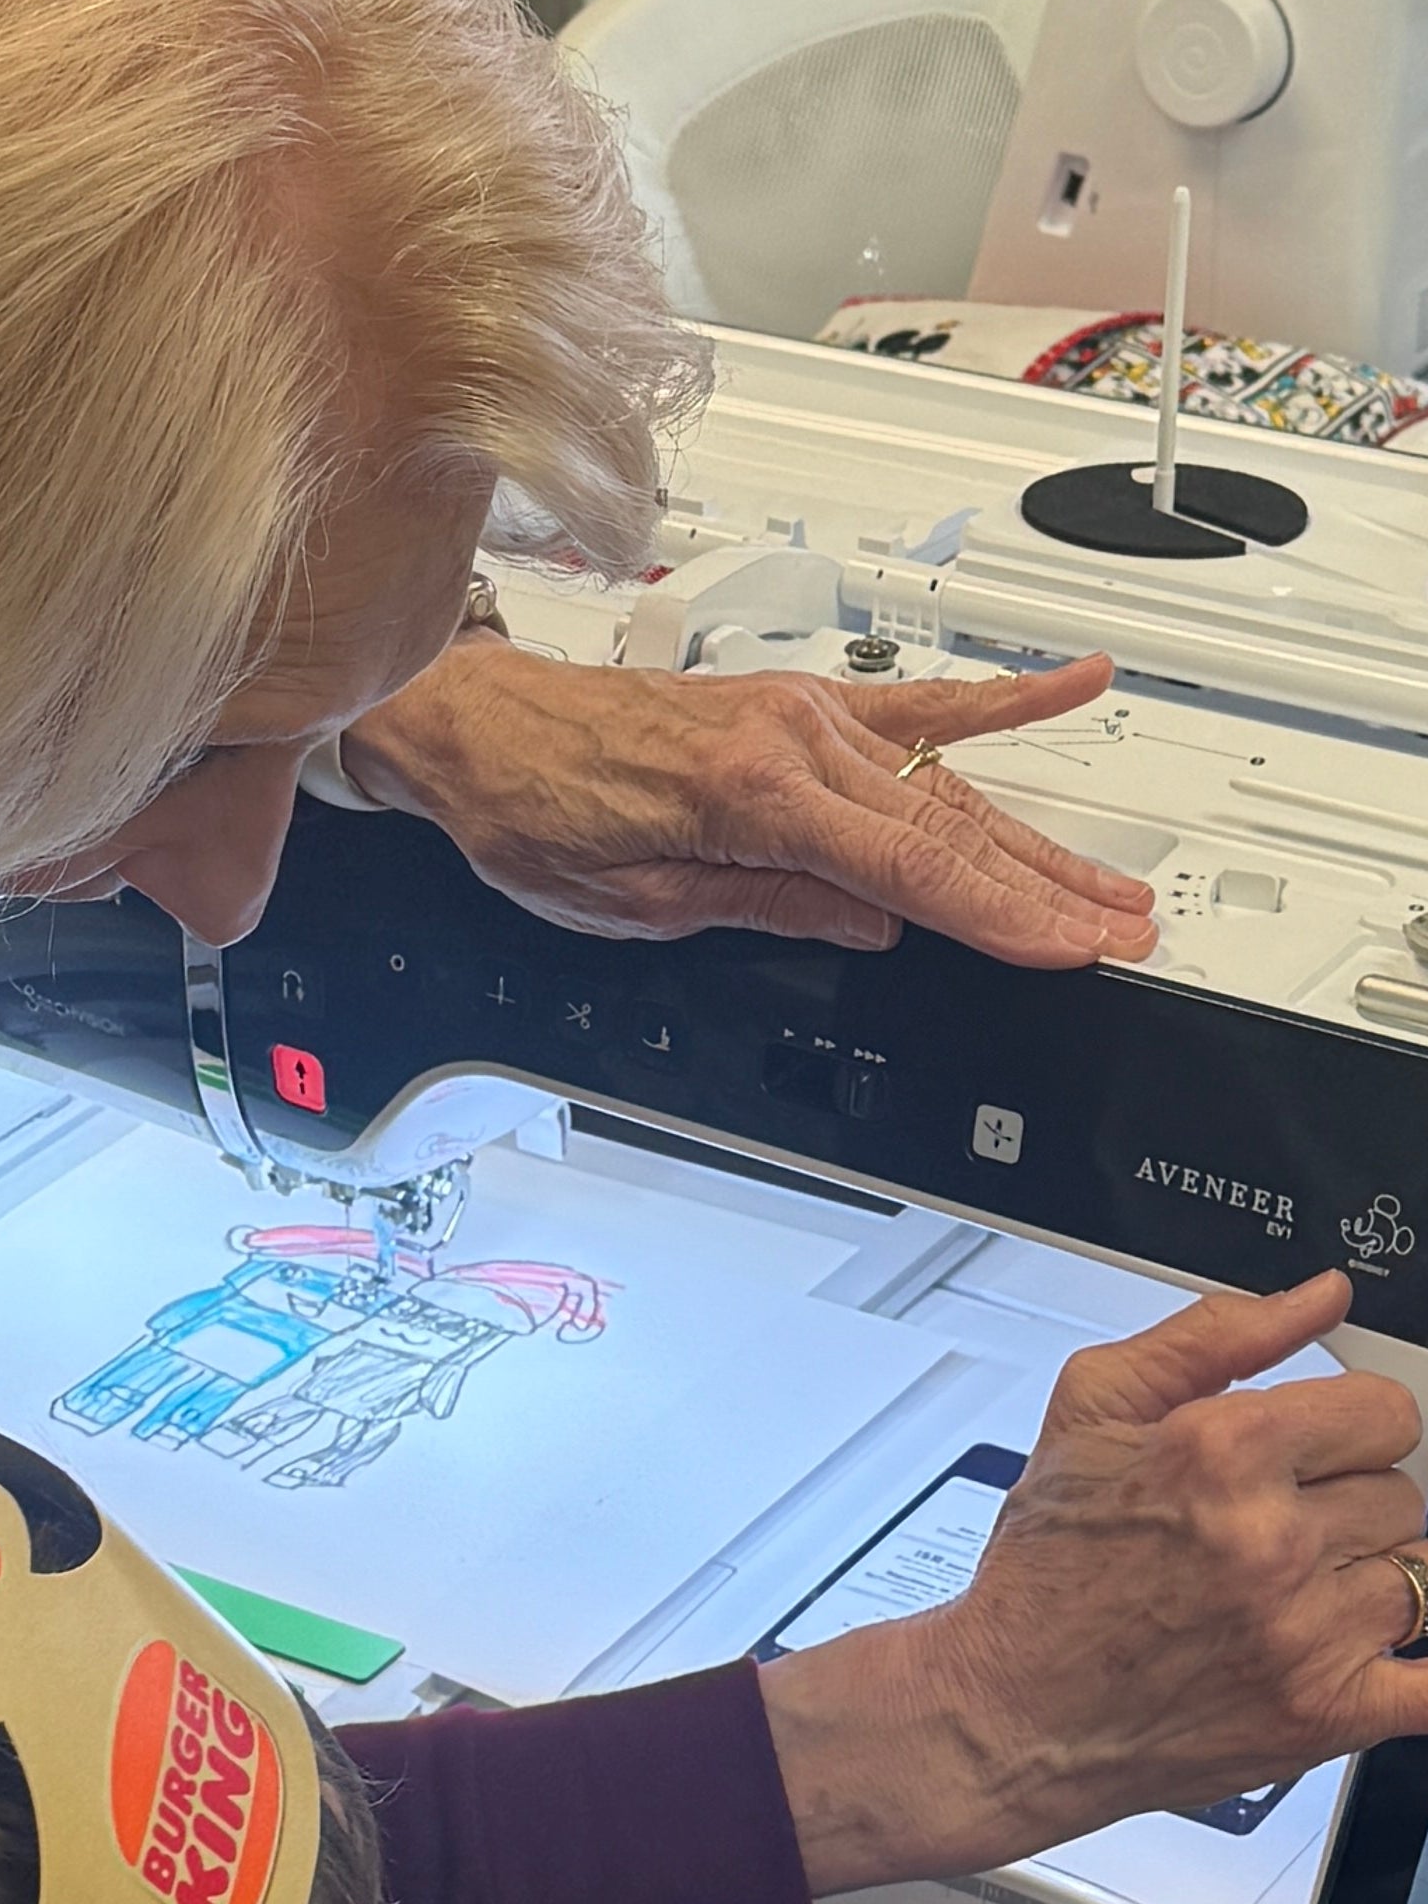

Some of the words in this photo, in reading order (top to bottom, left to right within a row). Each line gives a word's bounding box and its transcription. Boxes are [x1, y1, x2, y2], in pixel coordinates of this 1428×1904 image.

[1134, 1156, 1296, 1222] AVENEER
[1266, 1220, 1293, 1240] EV1
[142, 1659, 211, 1897] BURGER
